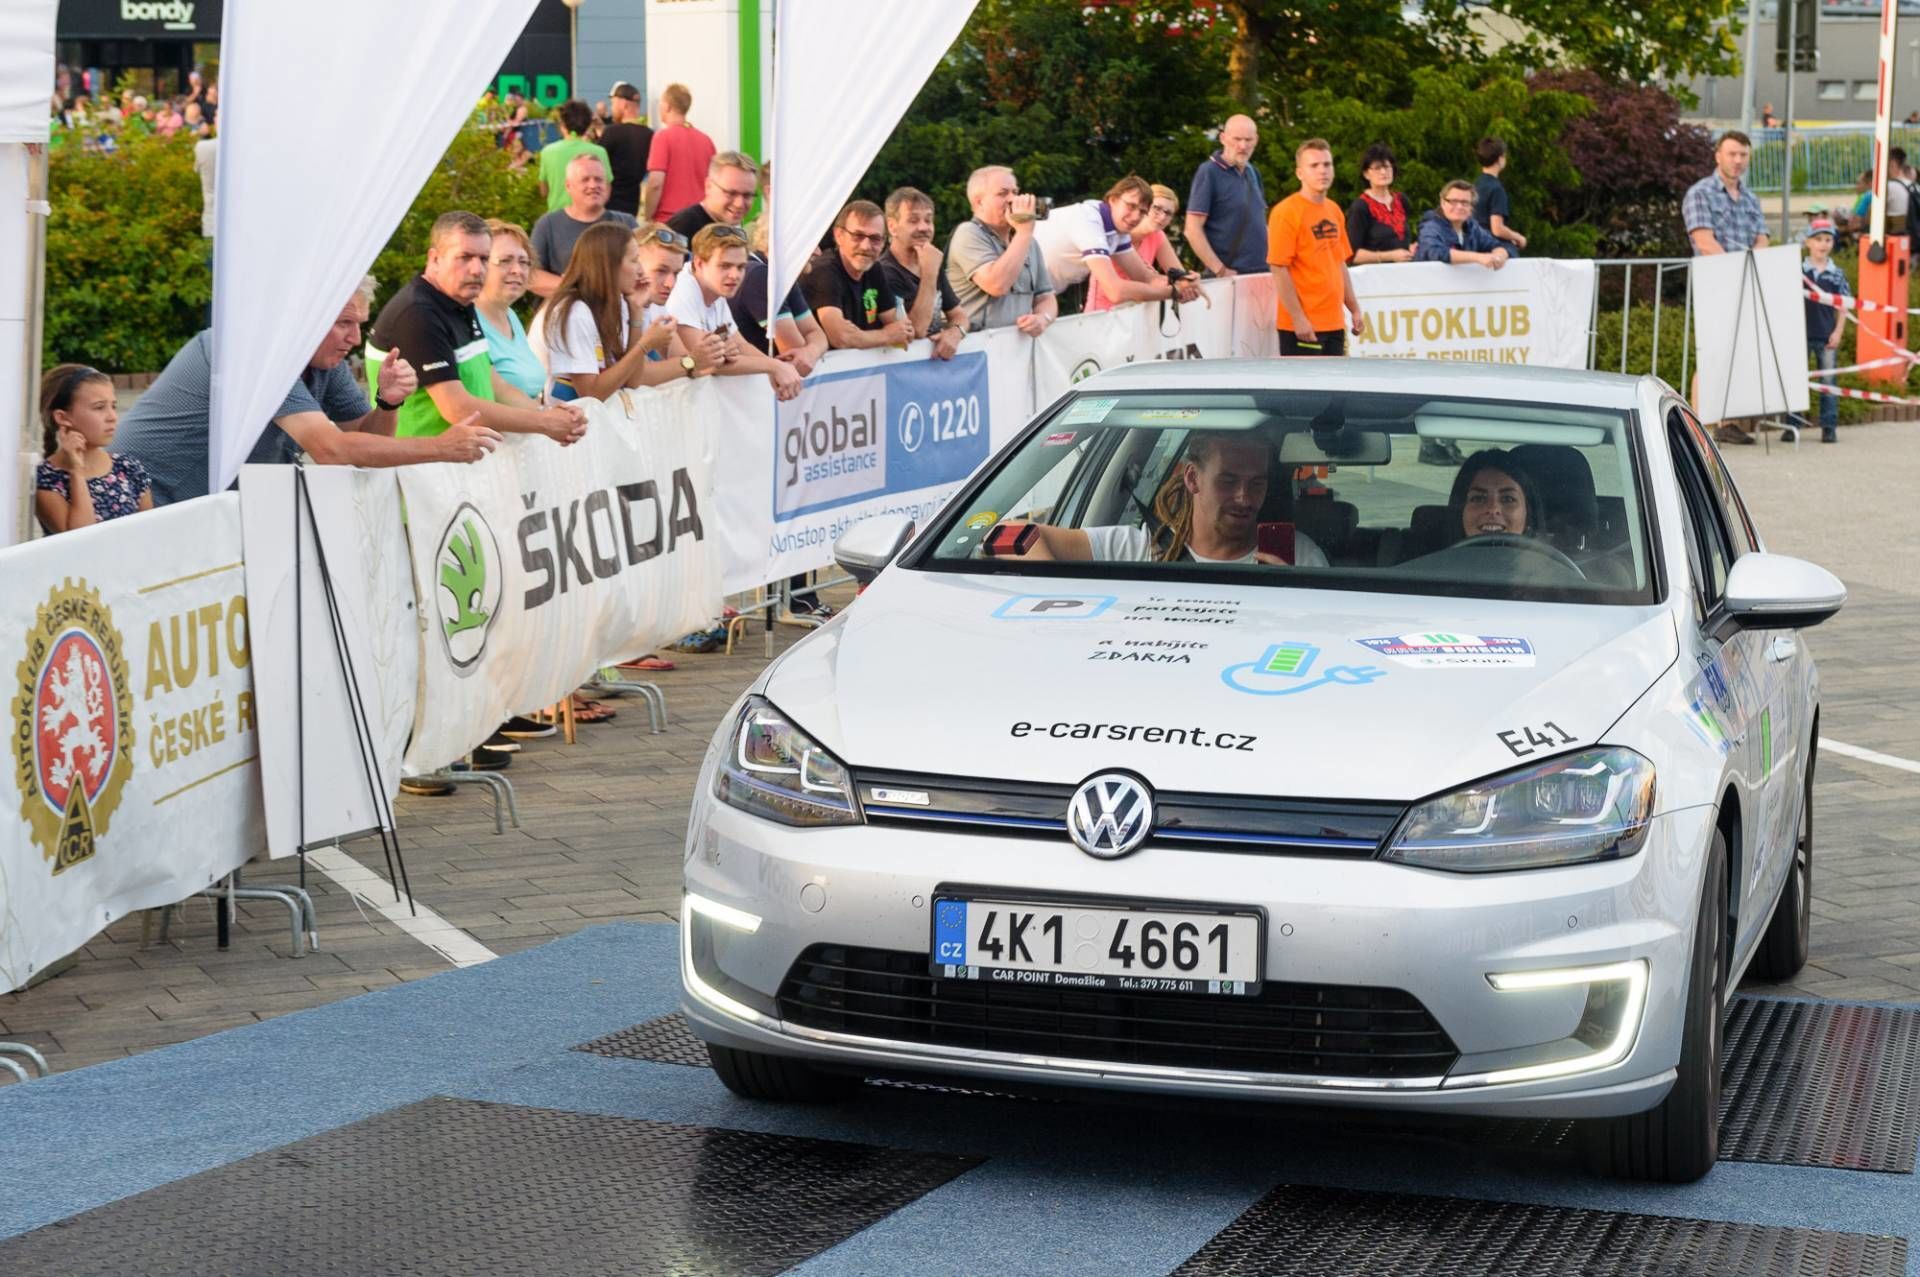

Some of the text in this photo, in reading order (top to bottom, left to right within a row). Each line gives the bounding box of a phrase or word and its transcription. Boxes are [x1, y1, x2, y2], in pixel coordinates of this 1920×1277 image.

[121, 0, 194, 23] bondy
[1359, 304, 1531, 344] AUTOKLUB
[929, 395, 980, 442] 1220
[784, 399, 877, 487] global
[803, 451, 878, 482] assistance
[517, 467, 704, 611] ŠKODA
[769, 524, 826, 557] Nonstop
[1087, 650, 1192, 664] ZDARMA
[19, 597, 130, 798] AUTOKLUB ČESKÉ REPUBLIKY
[149, 688, 225, 769] ČESKÉ
[1010, 720, 1258, 752] e-carsrent.cz
[1495, 721, 1579, 757] E41
[940, 942, 963, 959] CZ
[978, 910, 1230, 975] 4K1 4661
[992, 969, 1015, 981] CAR
[1017, 970, 1050, 984] POINT
[1055, 974, 1106, 987] Domažlice
[1140, 978, 1157, 989] 379
[1160, 979, 1177, 990] 775
[1178, 980, 1194, 991] 611
